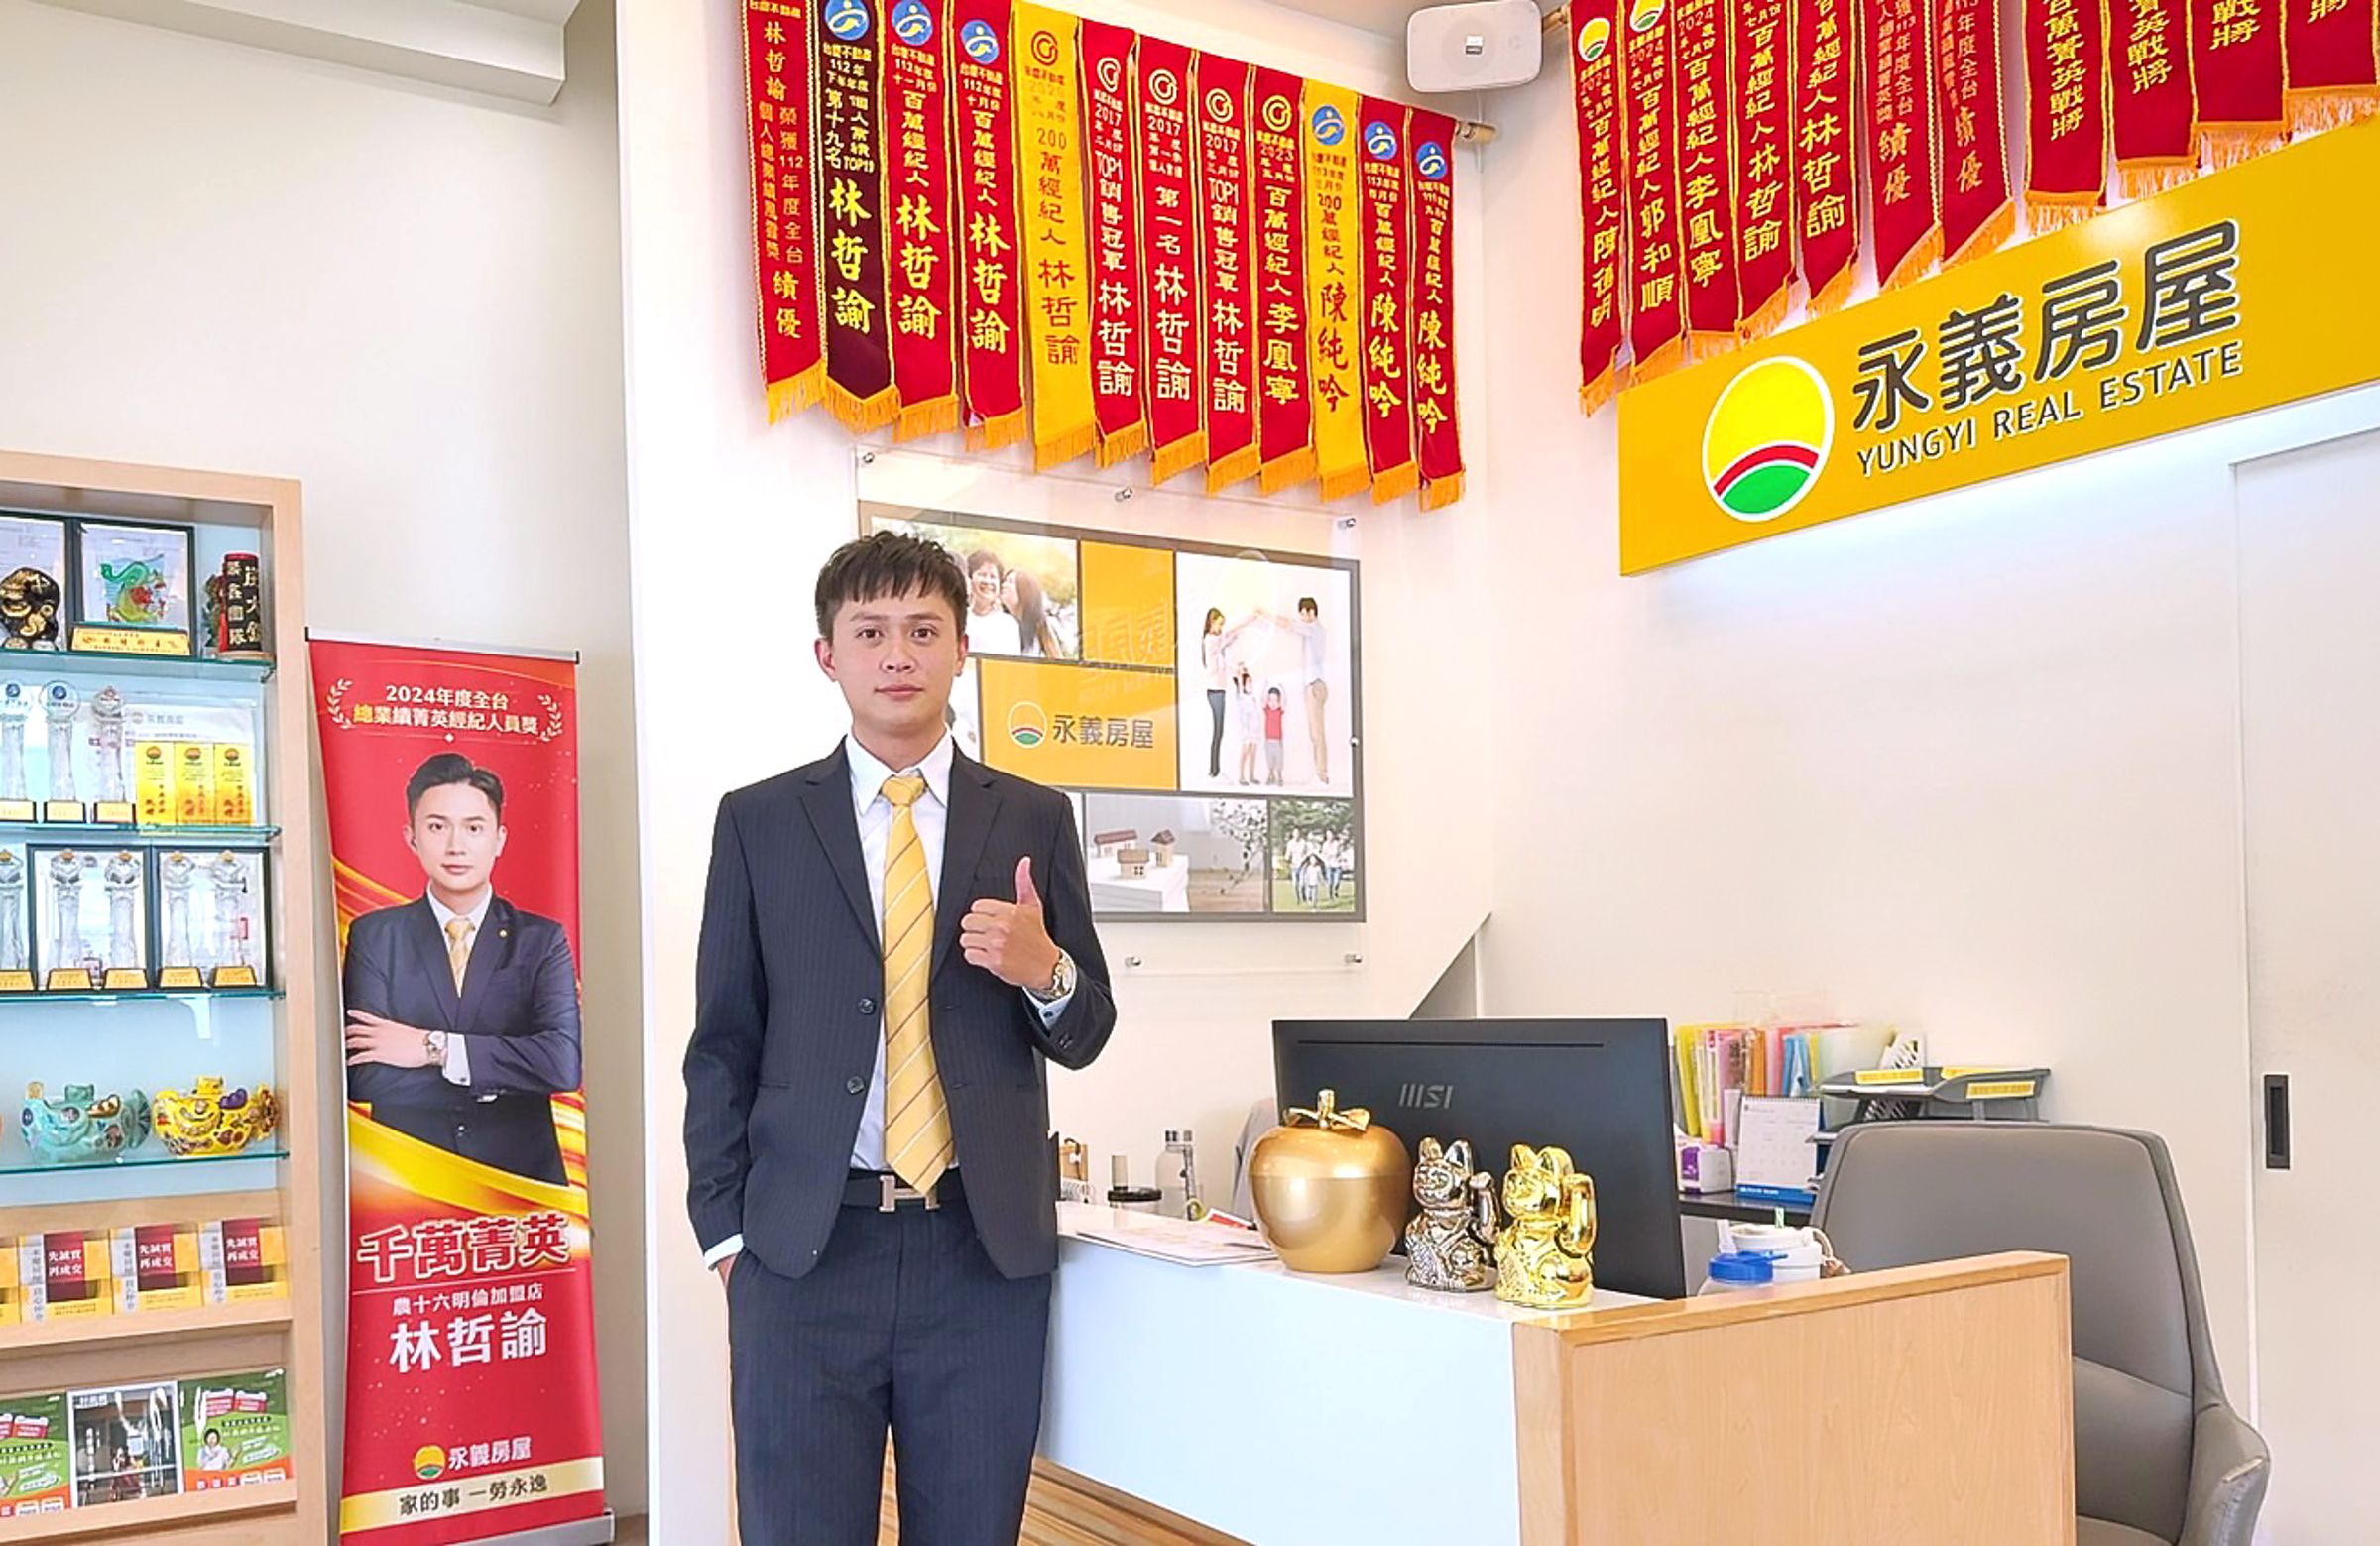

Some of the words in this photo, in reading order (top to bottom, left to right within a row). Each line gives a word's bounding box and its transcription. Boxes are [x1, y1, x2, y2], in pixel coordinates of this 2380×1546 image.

[1630, 39, 1664, 67] 2024
[1678, 7, 1713, 36] 2024
[824, 87, 845, 170] 第十九名
[1095, 103, 1122, 126] 2017
[1147, 116, 1181, 137] 2017
[1206, 133, 1238, 154] 2017
[1877, 122, 1912, 206] 績優
[828, 176, 876, 334] 林哲諭
[774, 270, 801, 339] 績優
[1038, 258, 1079, 365] 林哲諭
[1096, 279, 1135, 396] 林哲諭
[1854, 220, 2240, 433] 永義房屋
[1211, 299, 1245, 413] 林哲諭
[1317, 282, 1350, 413] 陳純吟
[1368, 292, 1402, 419] 陳純吟
[1416, 309, 1448, 434] 陳純吟
[1857, 417, 1979, 477] YUNGYI
[1993, 390, 2082, 435] REAL
[2100, 342, 2243, 408] ESTATE
[353, 704, 538, 735] 總業績菁英經紀人員獎
[386, 685, 508, 711] 2024年度全台
[1053, 713, 1154, 749] 永義房屋
[1399, 1083, 1454, 1110] MSI
[357, 1210, 569, 1282] 千萬菁英
[393, 1283, 543, 1316] 農十六明倫加盟店
[390, 1307, 546, 1373] 林哲諭
[448, 1437, 532, 1470] 永義房屋
[400, 1488, 460, 1515] 家的事
[468, 1475, 547, 1501] 一勞永逸
